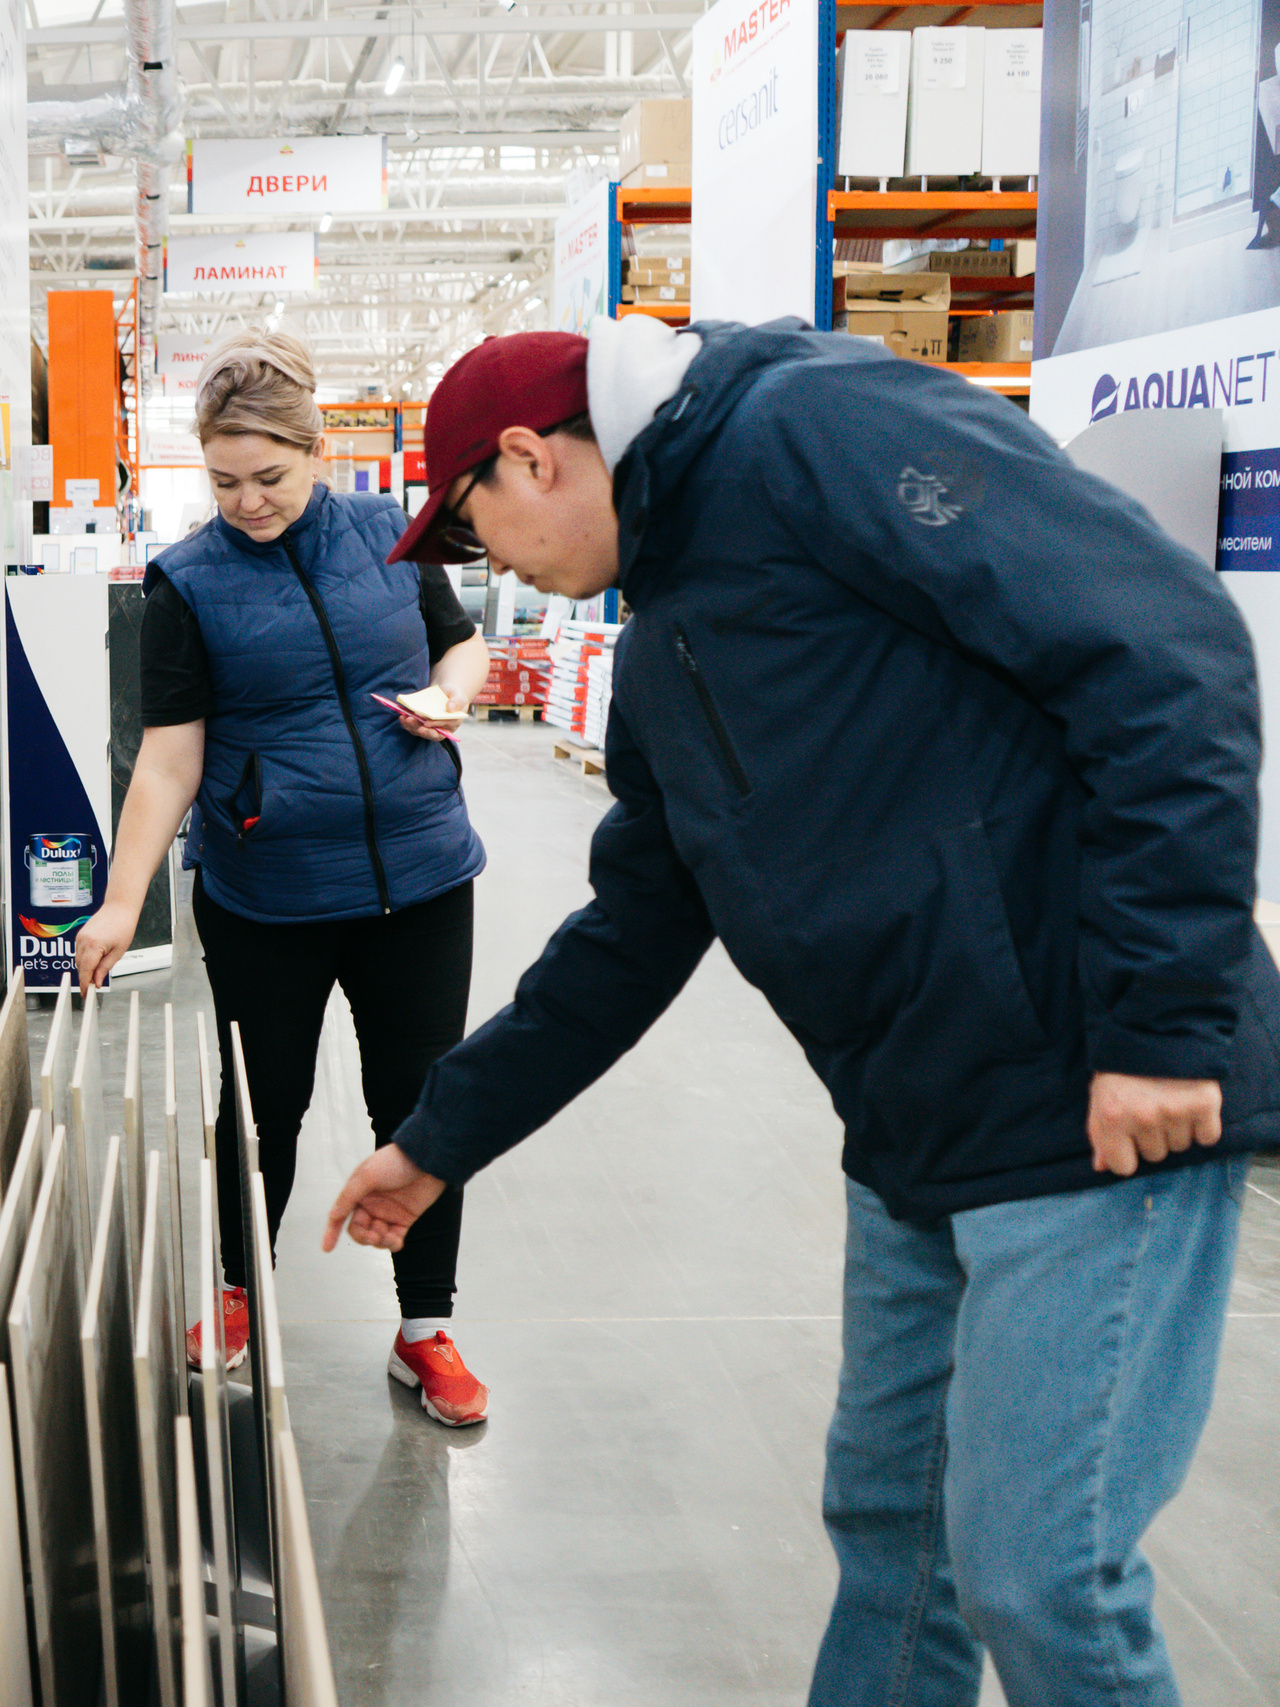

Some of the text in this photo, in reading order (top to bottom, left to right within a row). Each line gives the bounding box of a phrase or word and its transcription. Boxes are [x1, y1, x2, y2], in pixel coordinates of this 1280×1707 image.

[719, 65, 779, 150] cersanit
[247, 175, 328, 197] ДВЕРИ
[193, 265, 288, 281] ЛАМИНАТ
[172, 352, 208, 362] ЛИНО
[1123, 350, 1276, 412] AQUANET
[1255, 469, 1280, 488] КОМ
[1219, 537, 1272, 551] месители
[41, 847, 78, 858] Dulux
[20, 935, 77, 957] Dulu
[21, 958, 79, 970] let's col
